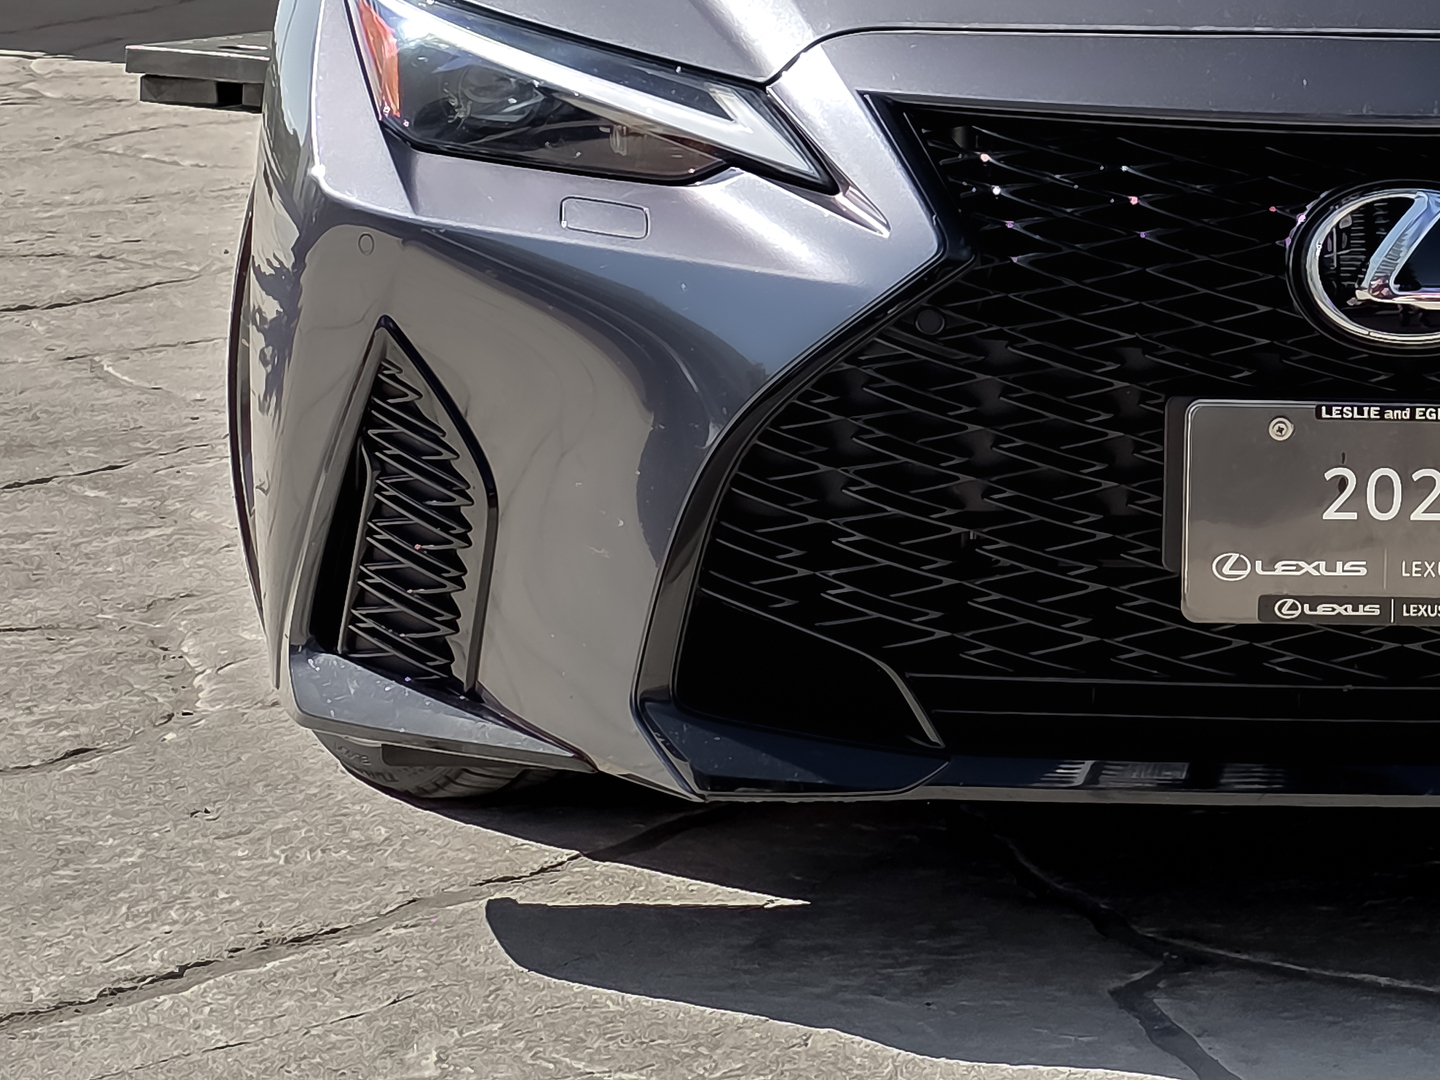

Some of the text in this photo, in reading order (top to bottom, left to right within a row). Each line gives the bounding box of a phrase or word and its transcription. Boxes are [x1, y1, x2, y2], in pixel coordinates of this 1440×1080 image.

[1321, 406, 1381, 419] LESLIE
[1384, 408, 1411, 420] and
[1255, 560, 1368, 576] LEXUS
[1303, 603, 1381, 616] LEXUS
